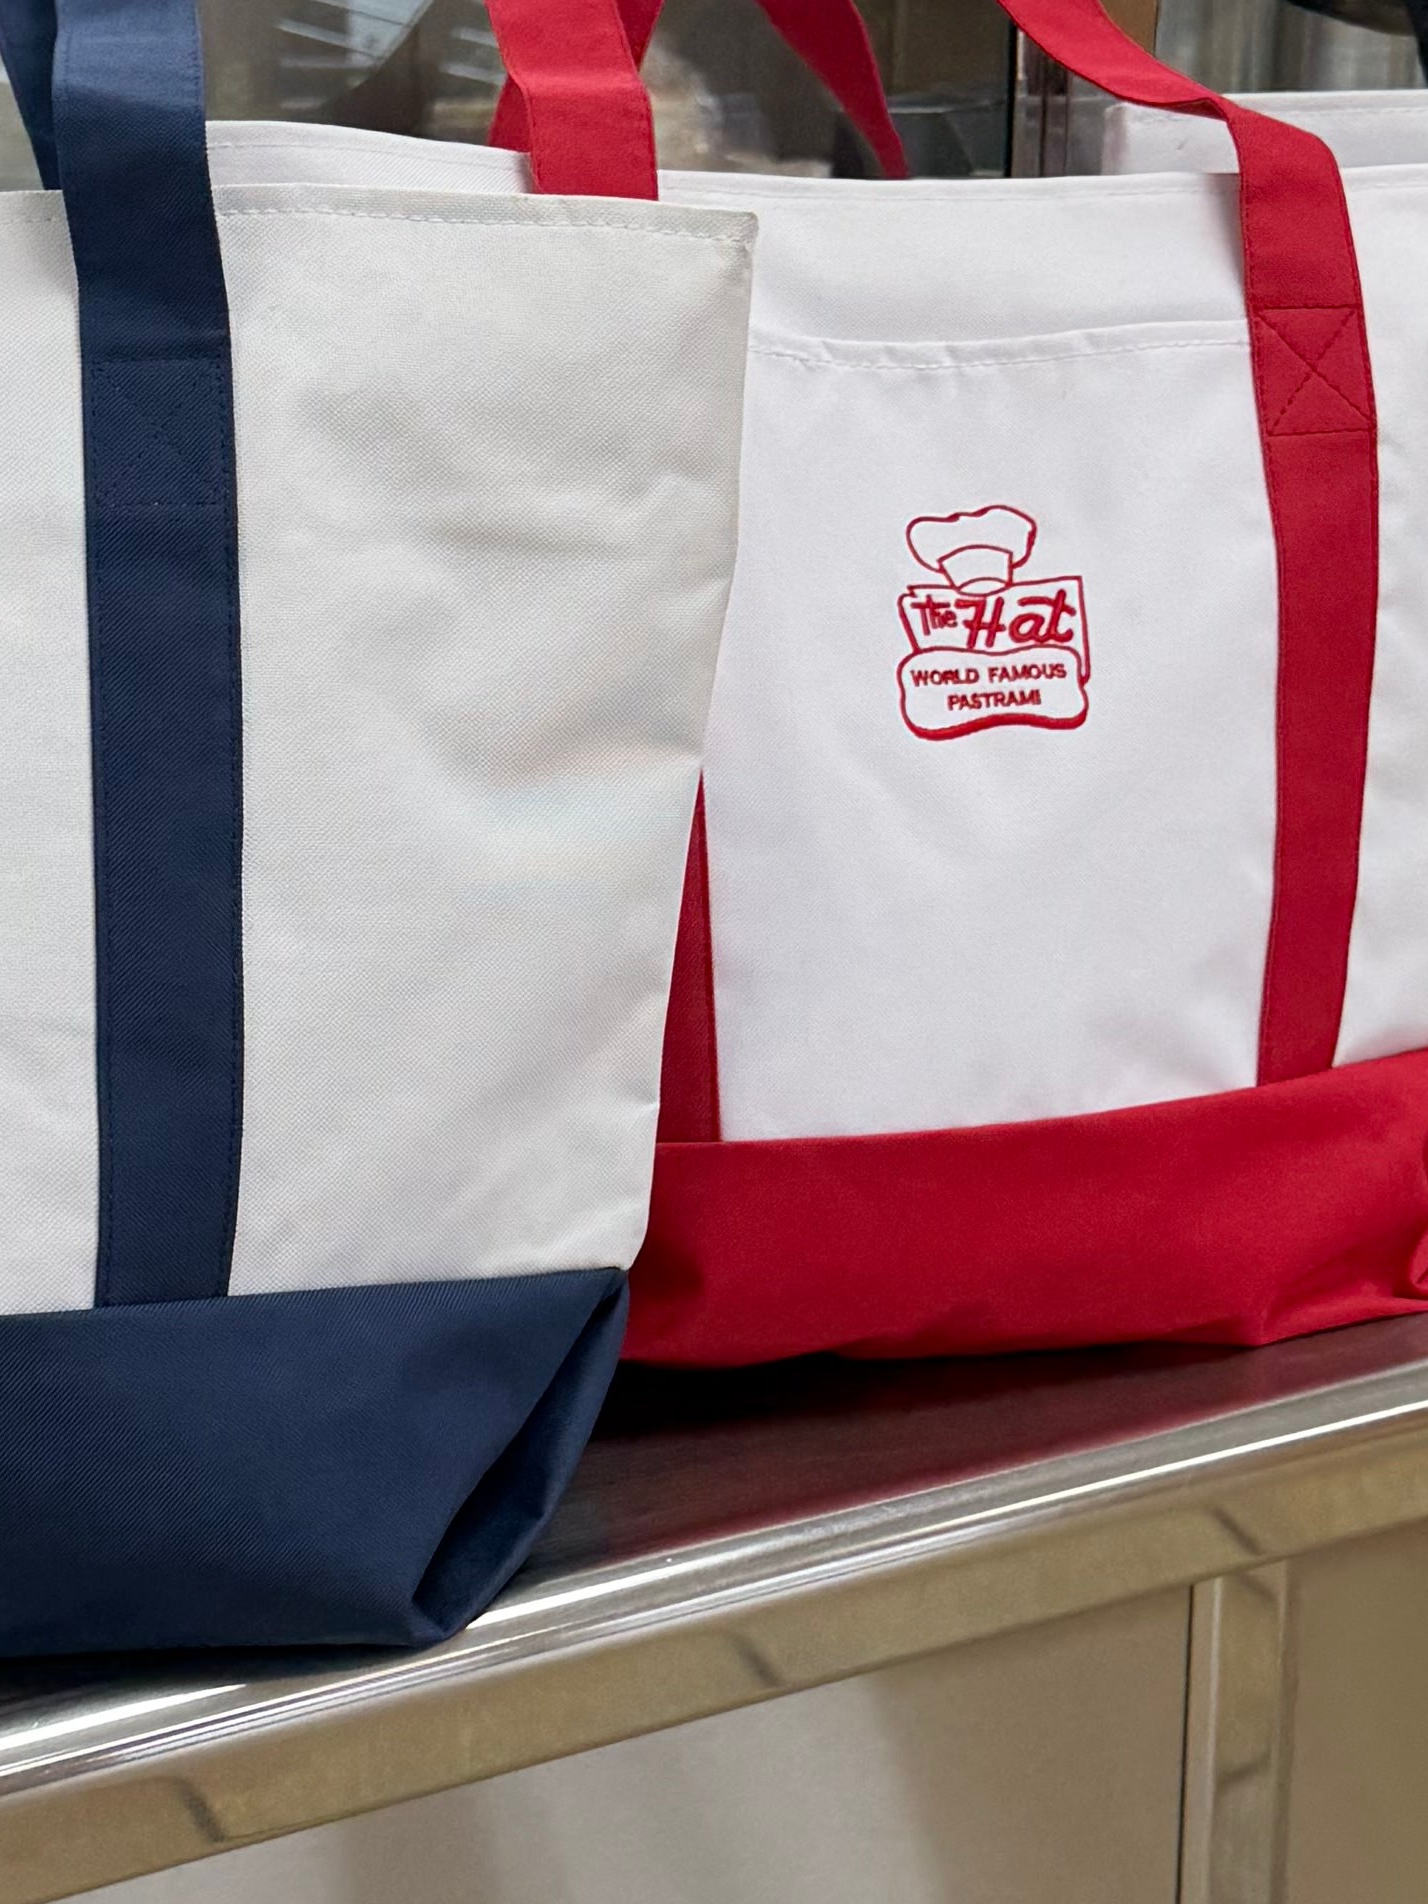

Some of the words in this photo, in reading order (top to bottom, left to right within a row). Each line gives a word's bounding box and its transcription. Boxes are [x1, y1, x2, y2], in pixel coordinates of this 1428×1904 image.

[911, 595, 958, 636] The
[955, 589, 1077, 649] Hat
[910, 667, 979, 687] WORLD
[988, 662, 1067, 683] FAMOUS
[947, 689, 1042, 710] PASTRAMI
